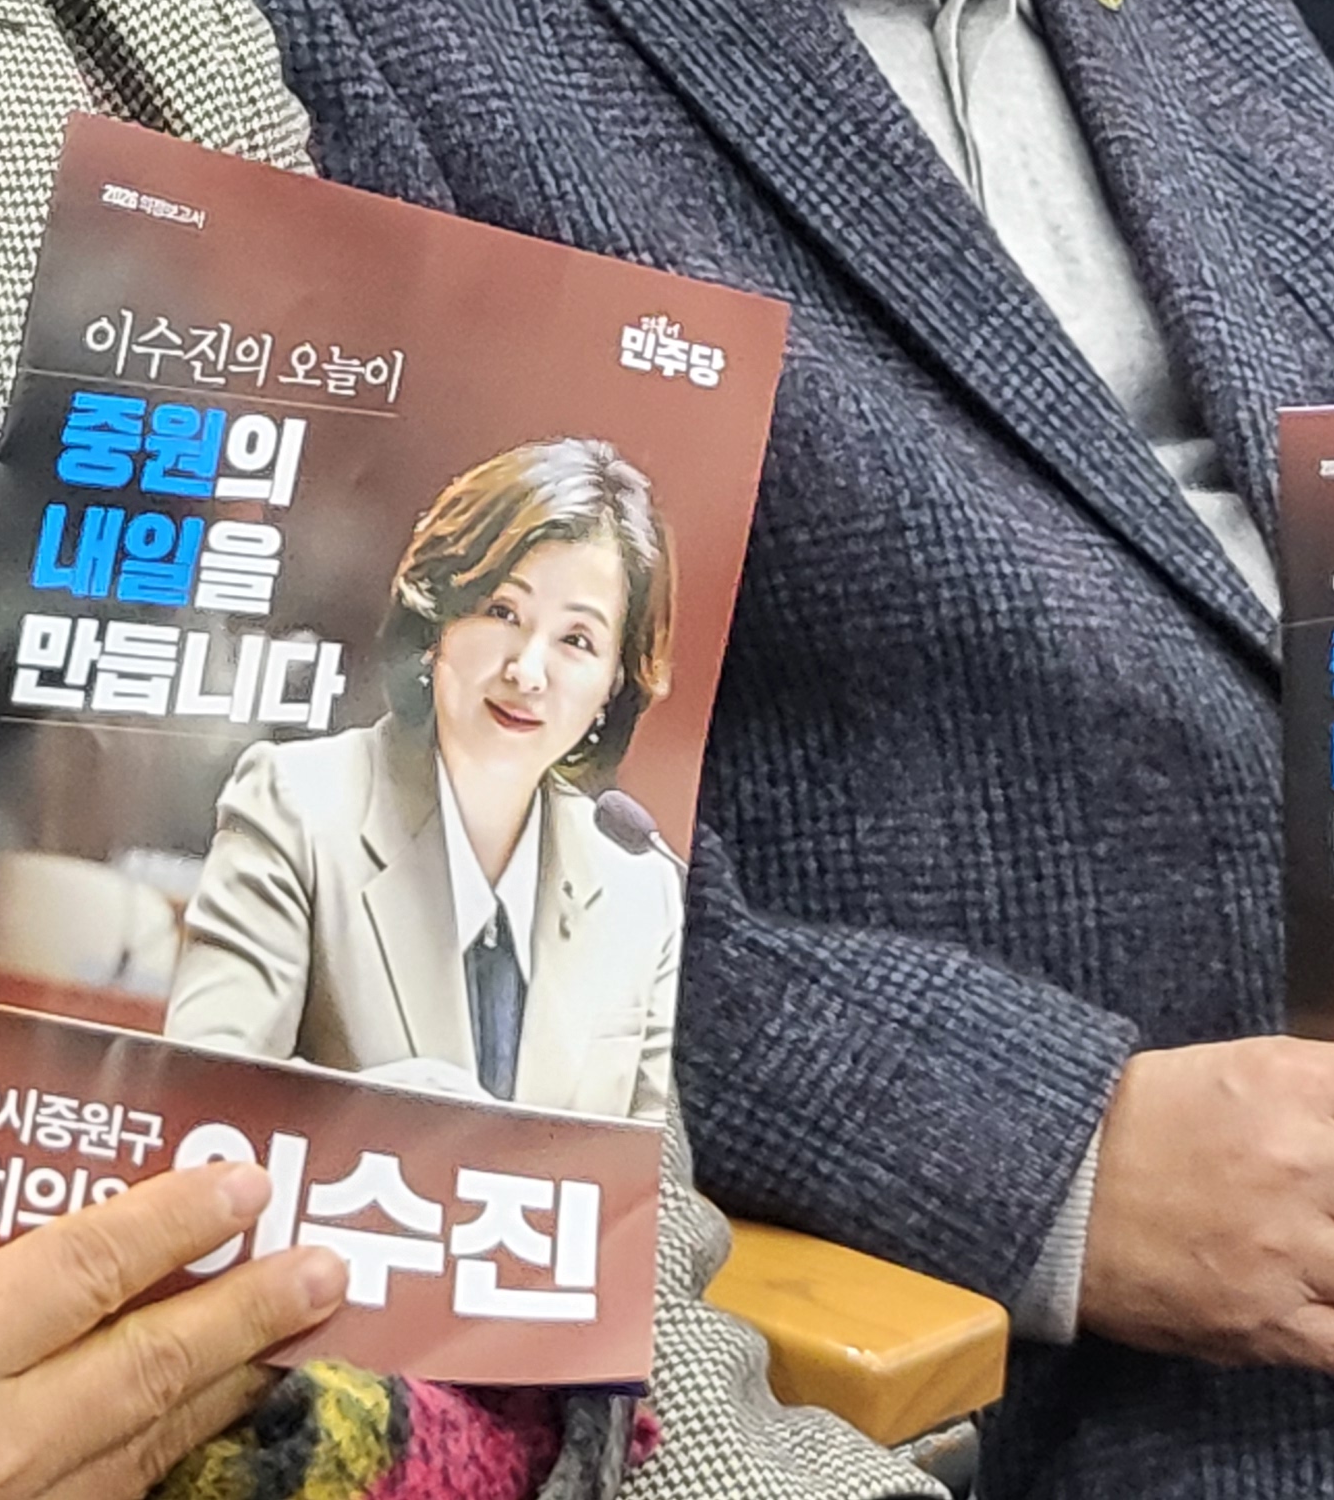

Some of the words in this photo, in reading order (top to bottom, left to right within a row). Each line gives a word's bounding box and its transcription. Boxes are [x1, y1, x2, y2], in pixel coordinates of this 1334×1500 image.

[85, 309, 273, 387] 이수진의
[278, 343, 404, 403] 오늘이
[620, 325, 725, 388] 민주당
[56, 390, 307, 508] 중원의
[30, 503, 282, 616] 내일을
[9, 612, 347, 730] 만듭니다
